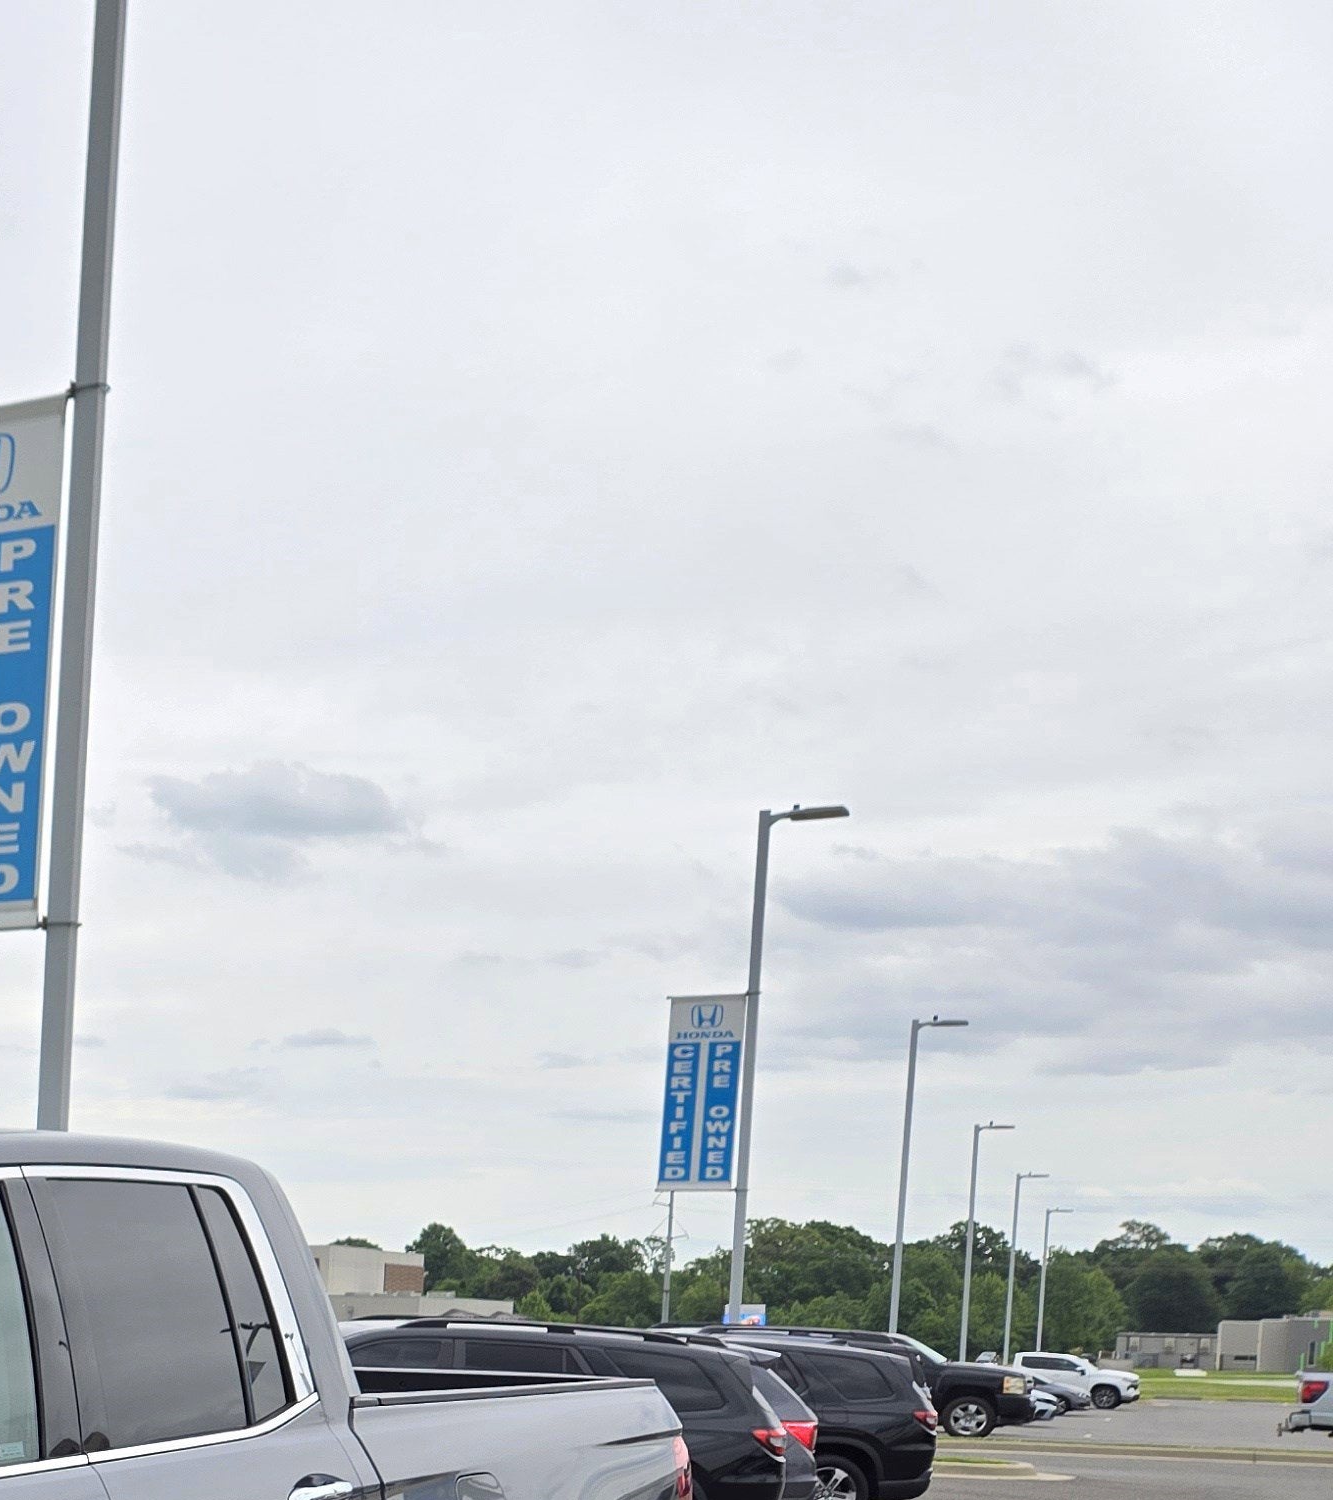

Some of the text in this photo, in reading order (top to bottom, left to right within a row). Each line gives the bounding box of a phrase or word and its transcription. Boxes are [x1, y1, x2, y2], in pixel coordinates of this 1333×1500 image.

[675, 1030, 734, 1040] HONDA
[664, 1044, 695, 1180] CERTIFIED
[705, 1043, 733, 1180] PRE OWNED
